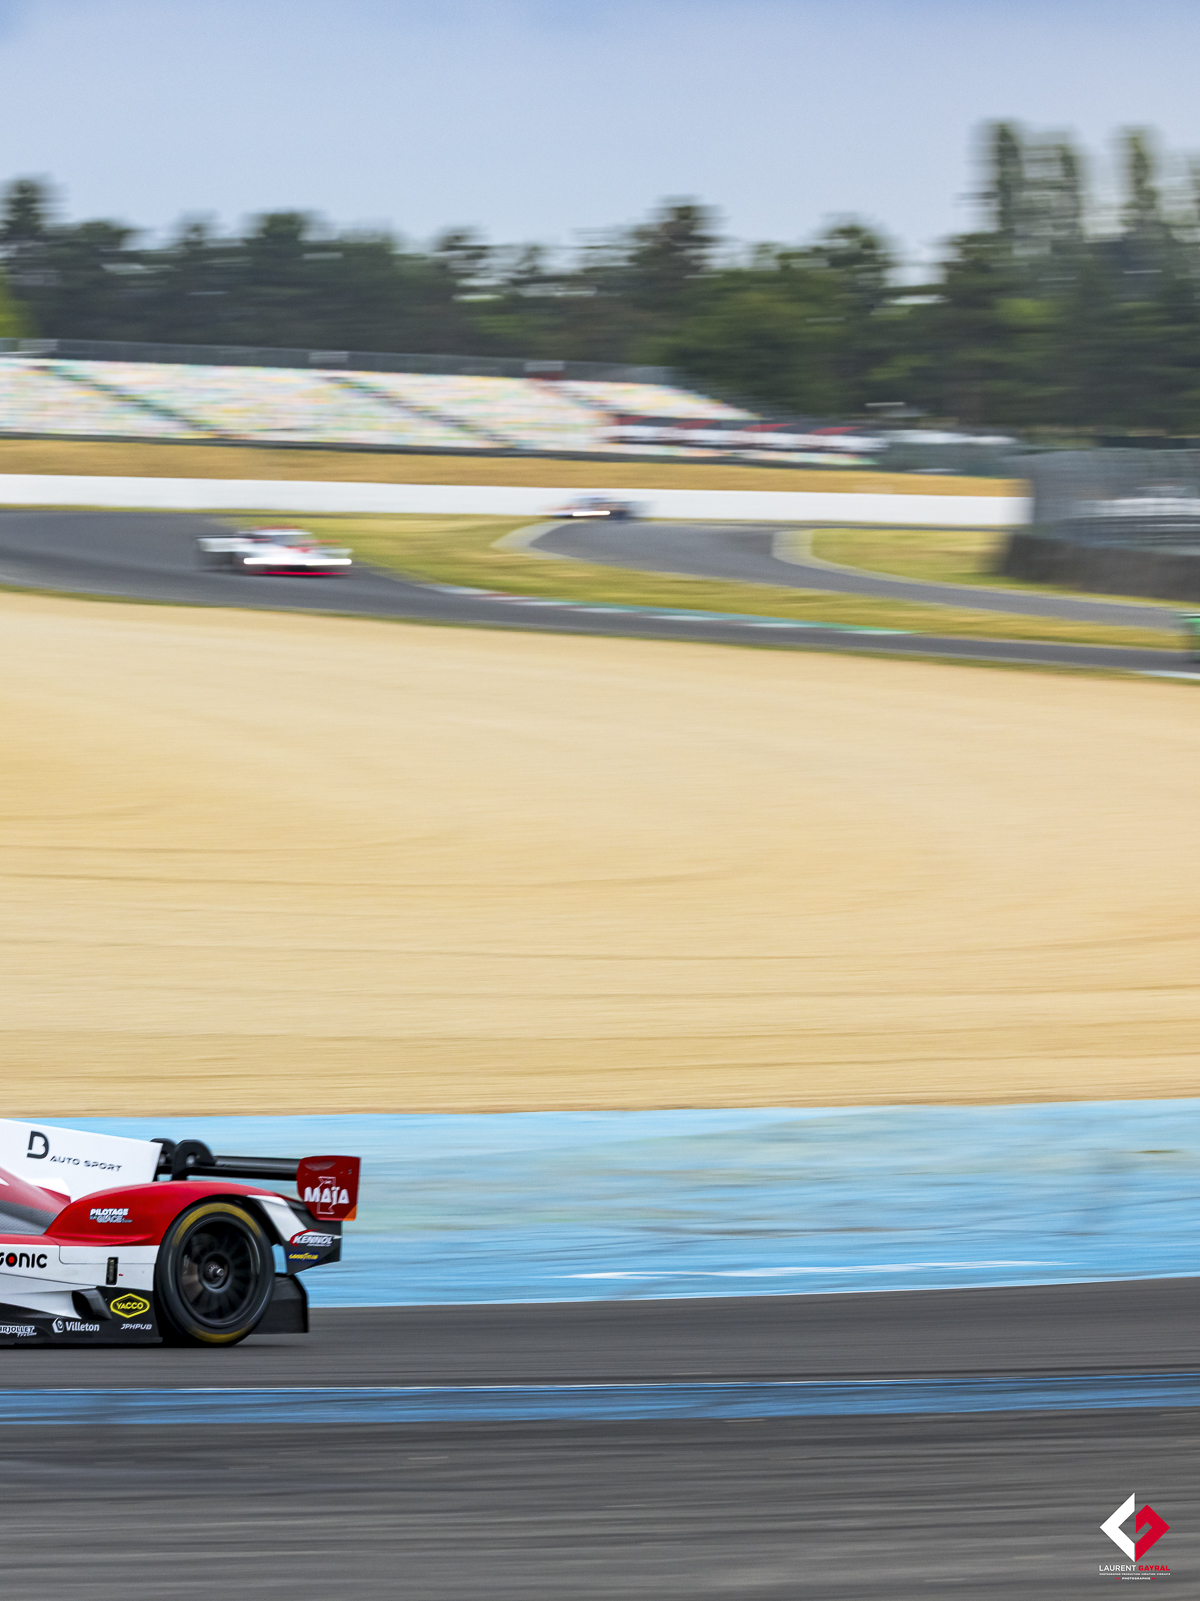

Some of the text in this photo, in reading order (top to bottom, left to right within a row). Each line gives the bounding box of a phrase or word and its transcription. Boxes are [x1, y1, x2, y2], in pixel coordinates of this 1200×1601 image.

[49, 1155, 123, 1172] AUTO SPORT
[304, 1186, 349, 1205] MAÏA
[89, 1208, 130, 1216] PILOTAGE
[293, 1236, 333, 1244] KENNOL
[116, 1301, 145, 1311] YACCO
[65, 1321, 100, 1332] Villeton
